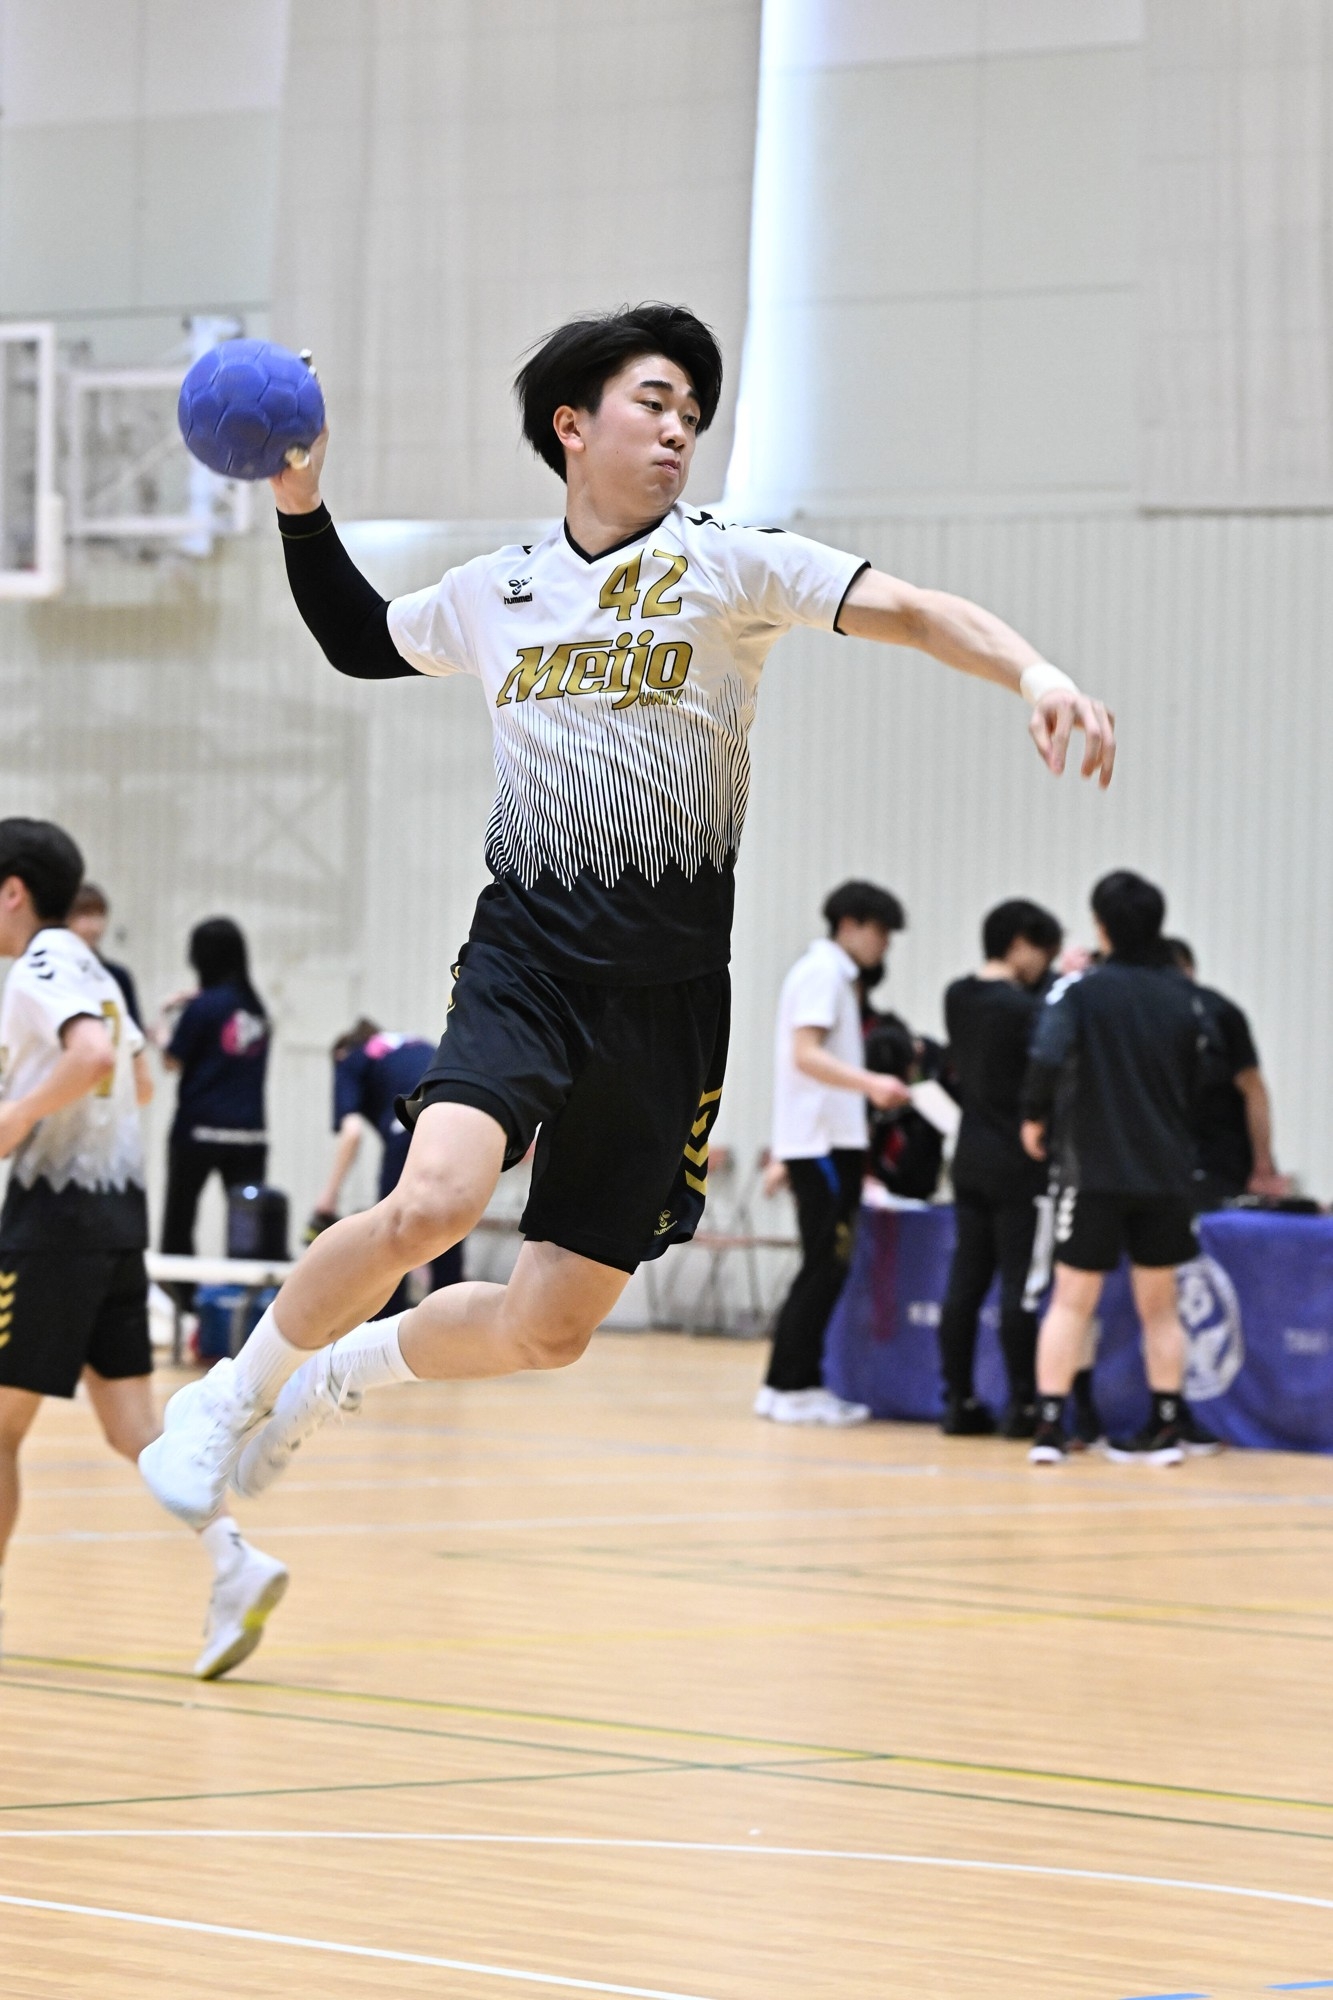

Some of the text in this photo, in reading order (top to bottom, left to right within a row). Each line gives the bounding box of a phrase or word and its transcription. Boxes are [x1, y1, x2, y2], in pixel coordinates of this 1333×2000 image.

[503, 592, 532, 604] hummel
[598, 548, 688, 621] 42
[496, 629, 693, 710] Meijo
[639, 689, 684, 706] UNIV.
